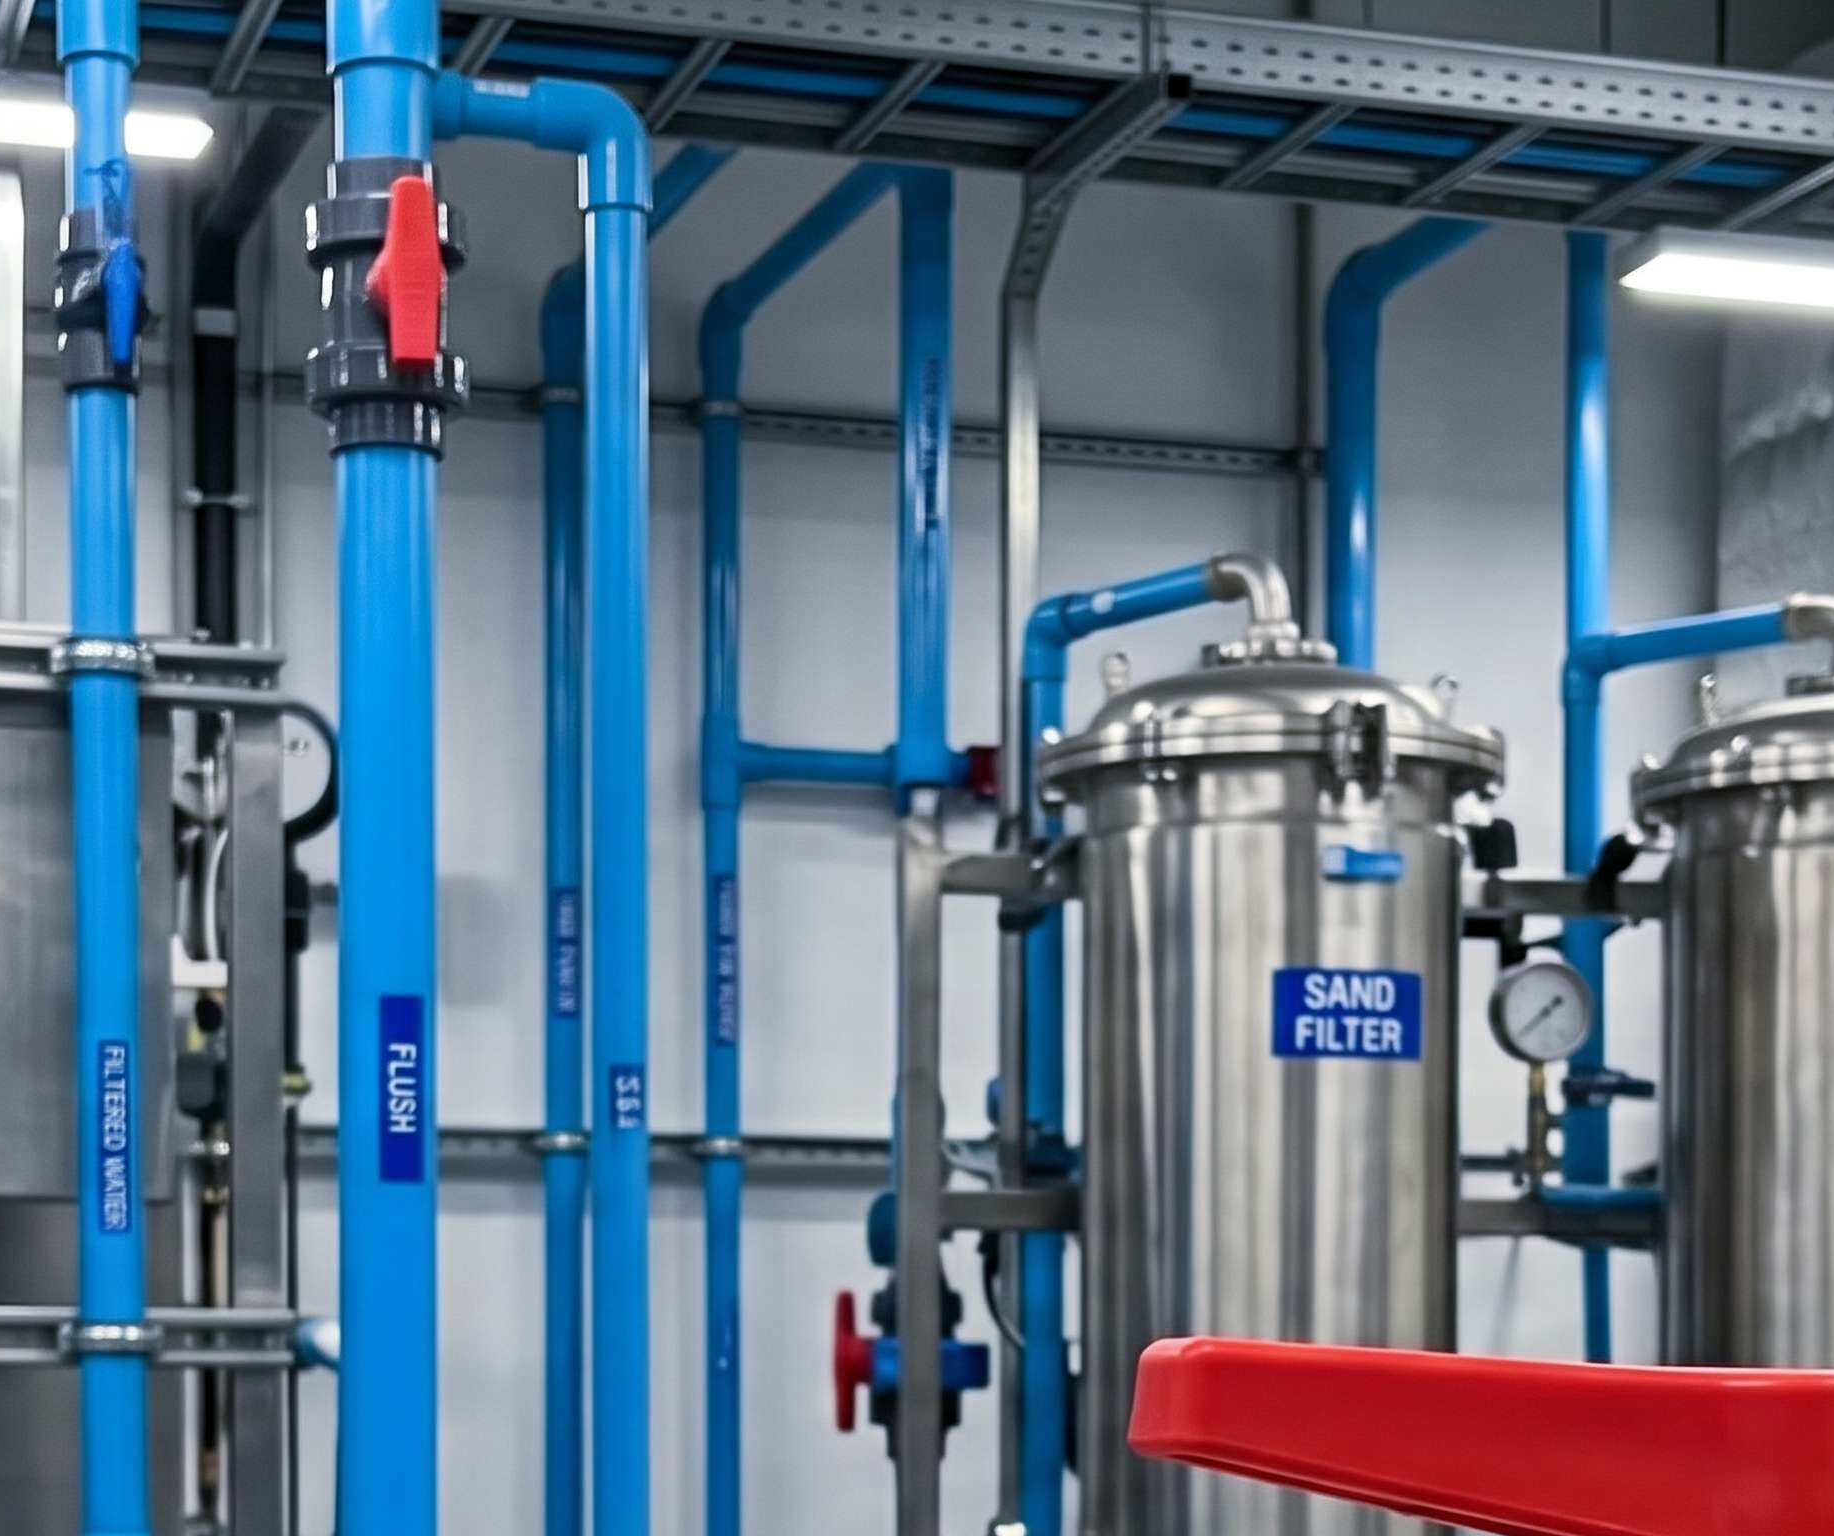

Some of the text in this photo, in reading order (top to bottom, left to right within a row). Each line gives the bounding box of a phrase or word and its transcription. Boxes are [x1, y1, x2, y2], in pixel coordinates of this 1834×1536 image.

[1304, 973, 1396, 1012] SAND
[1295, 1014, 1403, 1053] FILTER
[389, 1043, 417, 1133] FLUSH
[104, 1044, 127, 1231] FILTERED WATER
